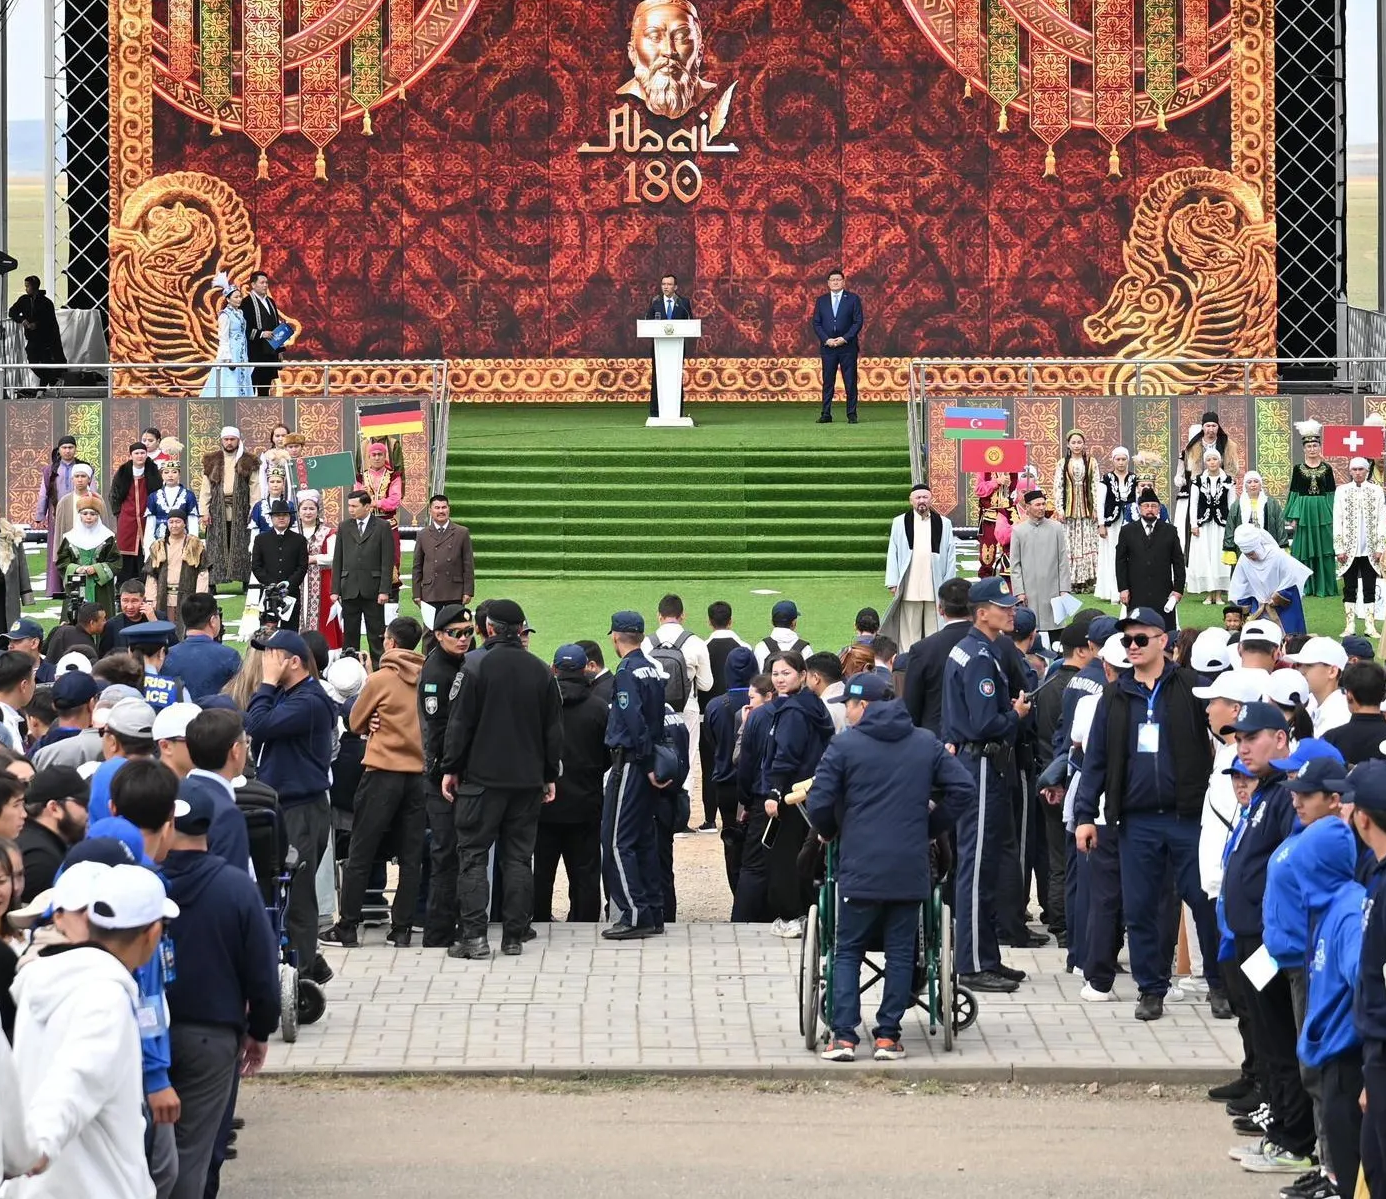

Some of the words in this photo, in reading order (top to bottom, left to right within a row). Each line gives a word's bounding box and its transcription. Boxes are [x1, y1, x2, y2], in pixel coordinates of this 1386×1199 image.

[576, 102, 740, 152] Abai
[623, 159, 703, 204] 180
[144, 675, 175, 691] RIST
[145, 690, 169, 704] ICE
